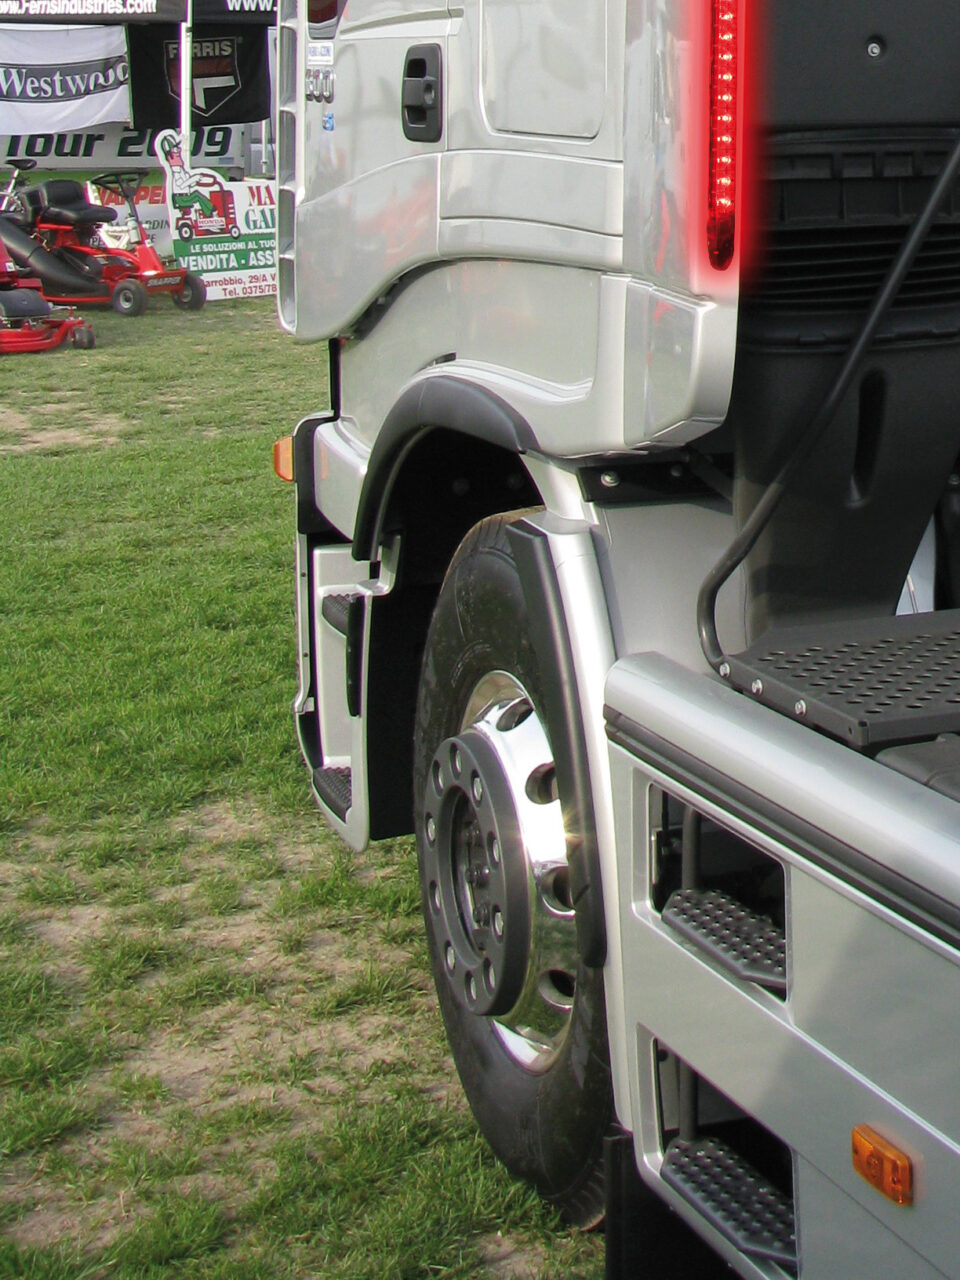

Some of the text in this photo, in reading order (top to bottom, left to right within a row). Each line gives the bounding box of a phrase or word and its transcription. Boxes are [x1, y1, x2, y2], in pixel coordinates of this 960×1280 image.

[202, 243, 245, 252] SOLUZIONI
[247, 241, 258, 249] AL
[180, 253, 238, 271] VENDITA
[222, 287, 240, 297] Tel.
